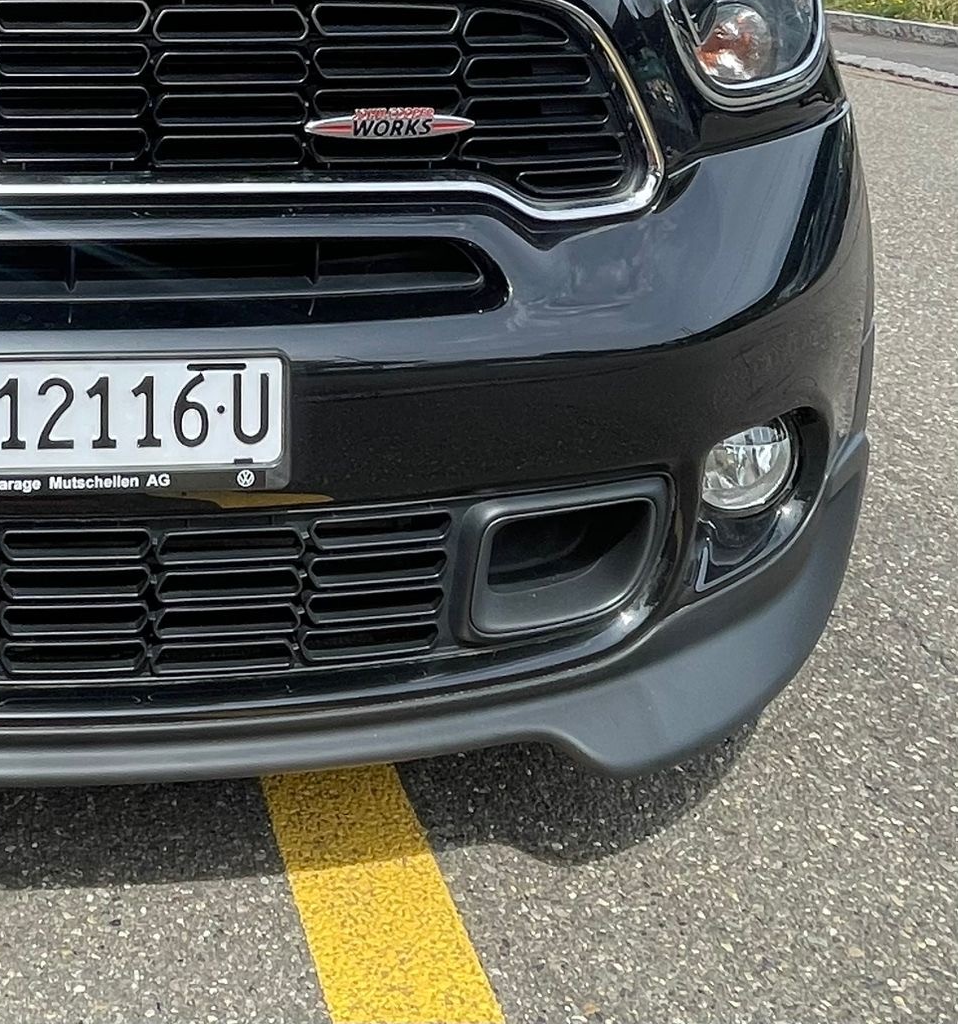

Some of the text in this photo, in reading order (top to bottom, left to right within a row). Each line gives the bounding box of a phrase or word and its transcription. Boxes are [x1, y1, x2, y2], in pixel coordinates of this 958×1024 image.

[353, 118, 433, 137] WORKS
[48, 474, 139, 490] Mutschellen
[146, 473, 171, 487] AG
